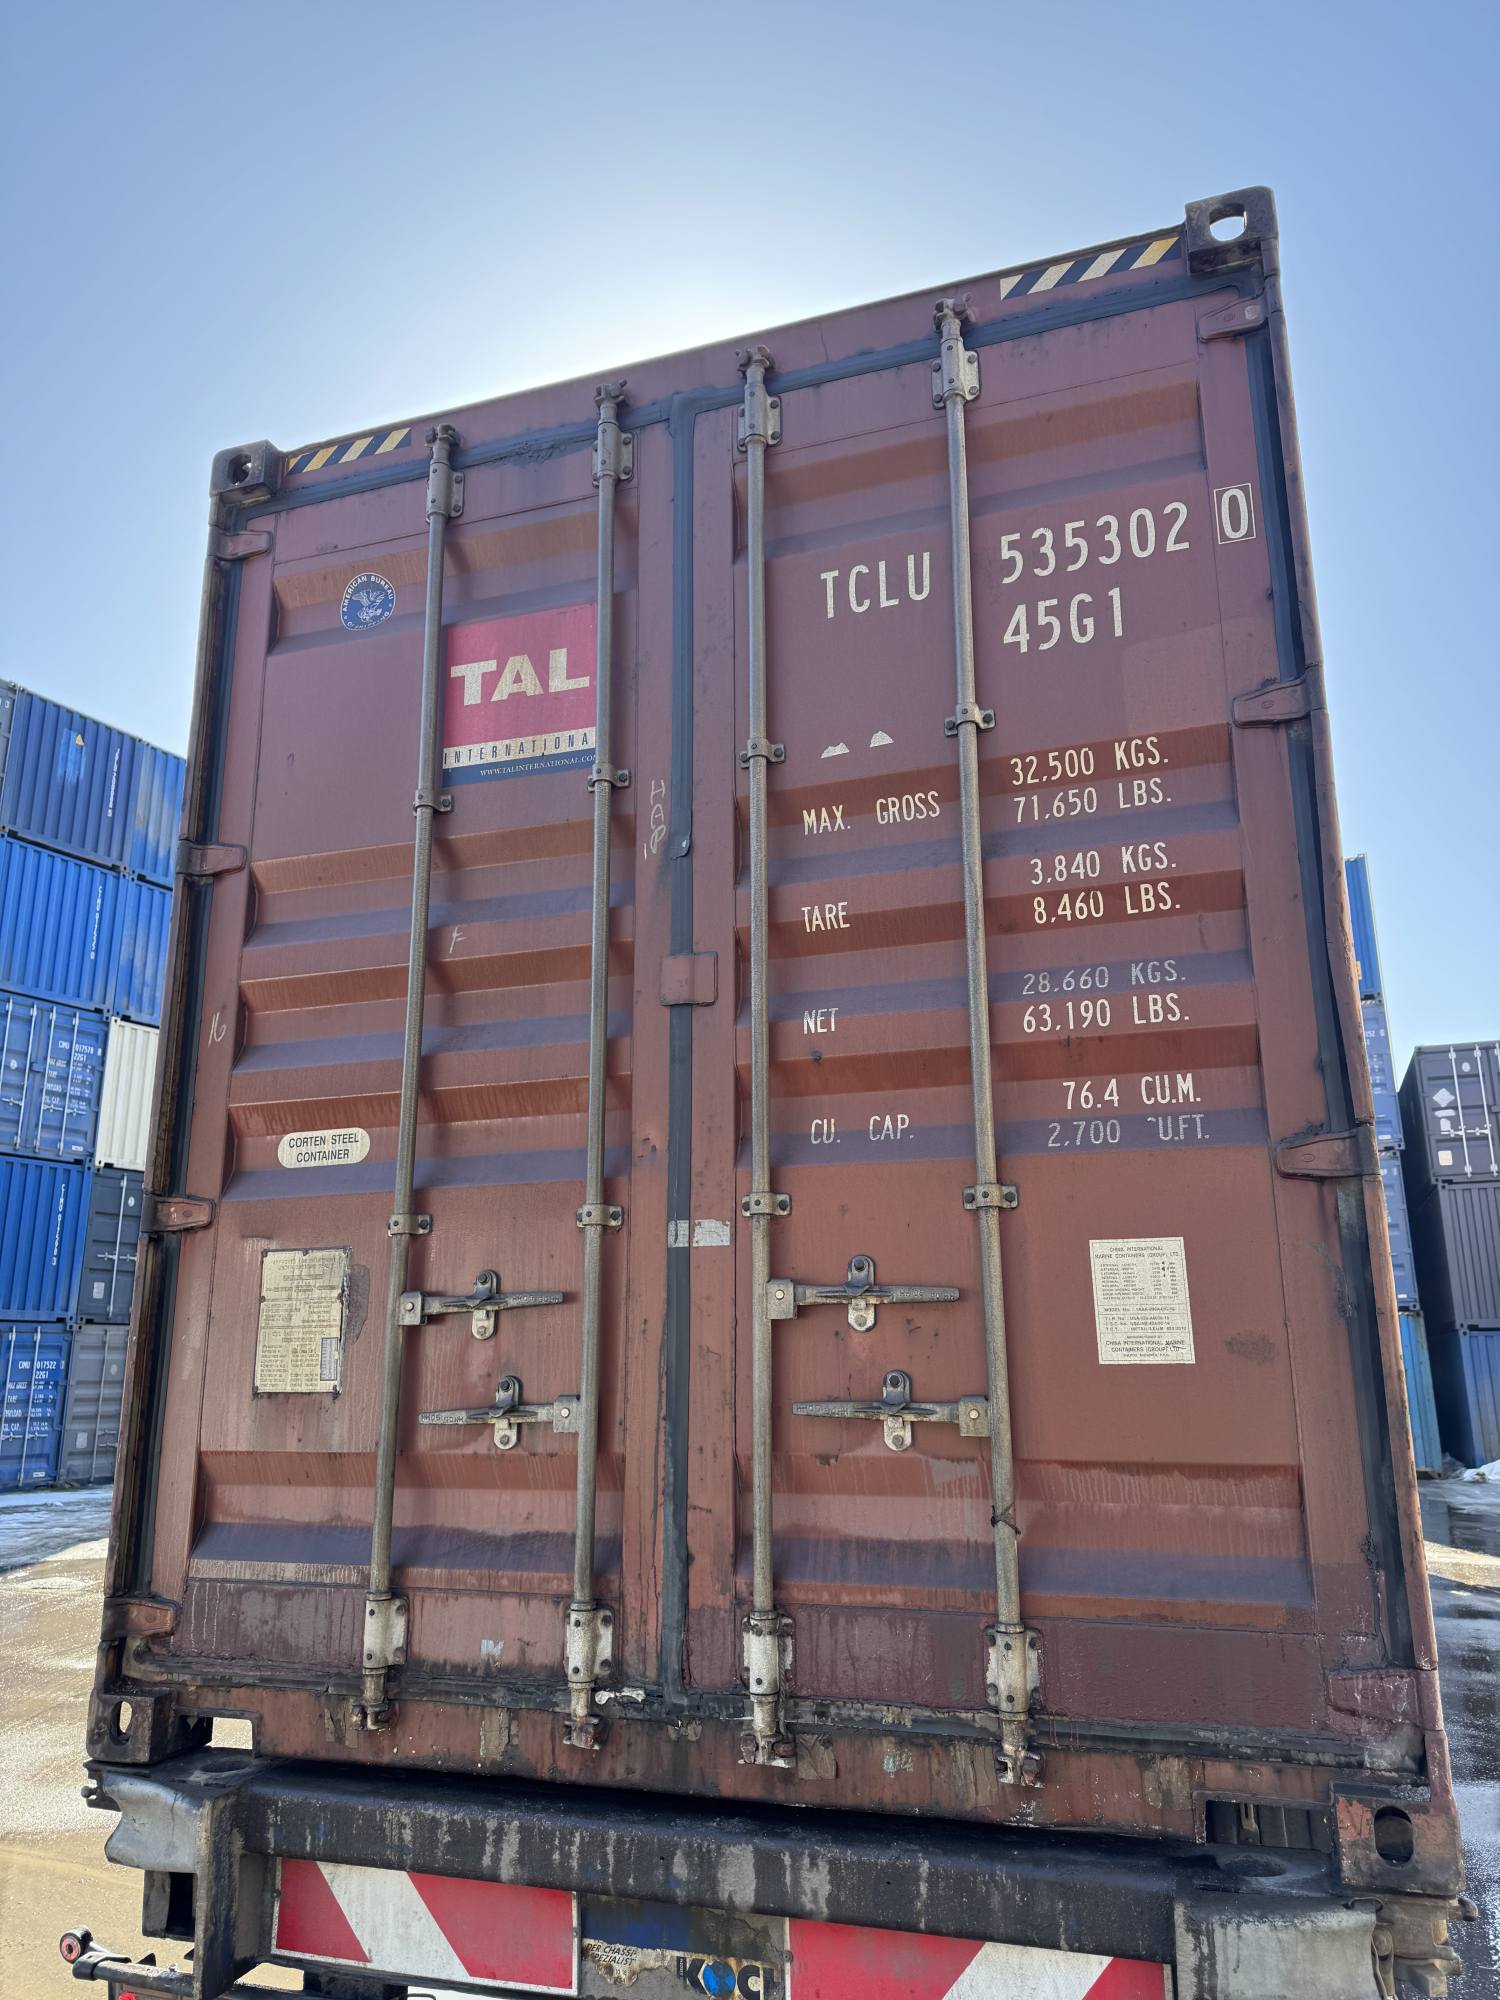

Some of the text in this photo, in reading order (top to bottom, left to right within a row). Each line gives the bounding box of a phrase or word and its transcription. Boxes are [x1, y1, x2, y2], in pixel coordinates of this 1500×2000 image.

[820, 488, 1249, 619] TCLU 535302 0
[342, 575, 394, 612] AMERICAN BUREAU
[1003, 587, 1123, 653] 45G1
[450, 648, 590, 706] TAL
[444, 732, 588, 765] INTERNATIONA
[1114, 736, 1169, 771] KGS.
[1118, 777, 1172, 809] LBS.
[802, 790, 941, 835] MAX. GROSS
[1121, 842, 1177, 874] KGS.
[1124, 881, 1181, 914] LBS.
[801, 901, 851, 932] TARE
[1131, 959, 1187, 985] KGS.
[803, 1007, 839, 1035] NET
[1132, 992, 1190, 1025] LBS.
[1062, 1072, 1202, 1110] 76.4 CU.M.
[288, 1133, 360, 1149] CORTEN STEEL
[810, 1113, 914, 1144] CU. CAP.
[1146, 1113, 1210, 1141] U.FT.
[296, 1148, 350, 1163] CONTAINER
[586, 1943, 602, 1952] DER
